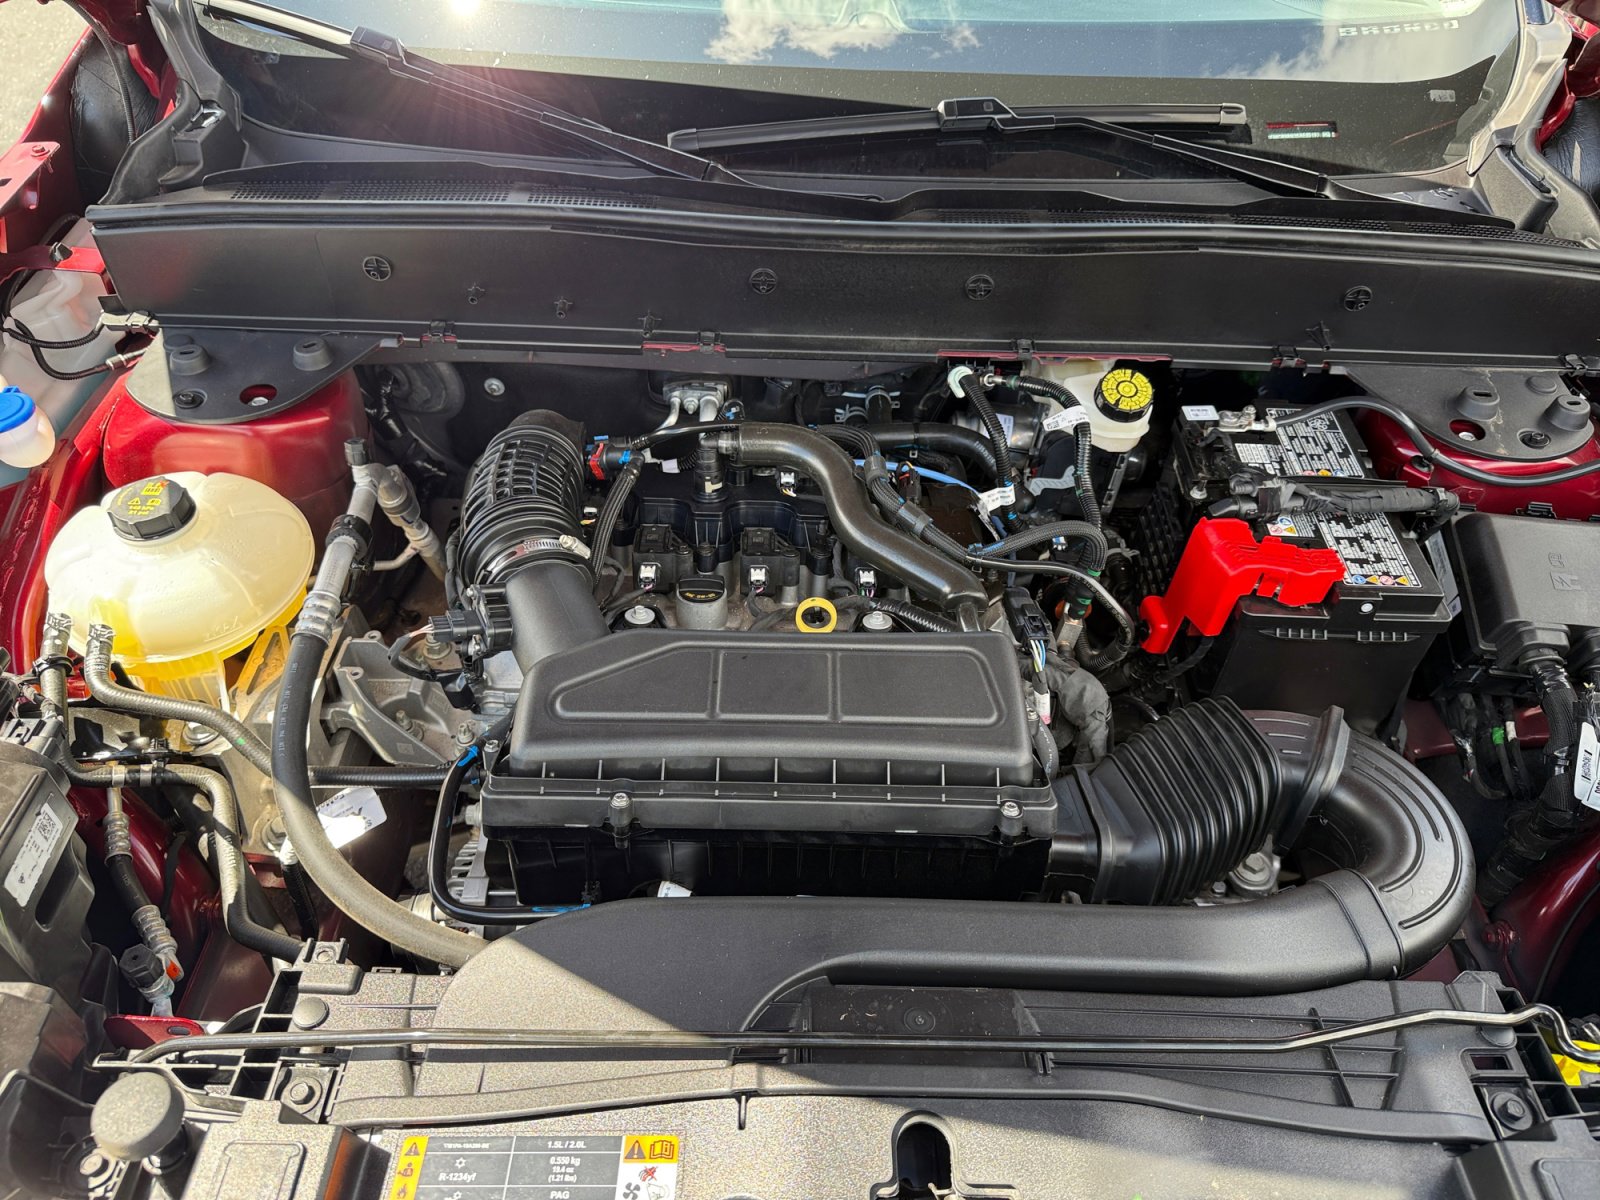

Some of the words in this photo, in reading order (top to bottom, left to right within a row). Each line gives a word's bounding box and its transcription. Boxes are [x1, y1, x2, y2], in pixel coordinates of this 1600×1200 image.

[547, 1140, 564, 1149] 1.5L
[569, 1140, 587, 1149] 2.0L
[550, 1156, 570, 1165] 0.550
[570, 1156, 581, 1166] kg
[438, 1172, 477, 1183] R-1234yf
[549, 1190, 570, 1200] PAG
